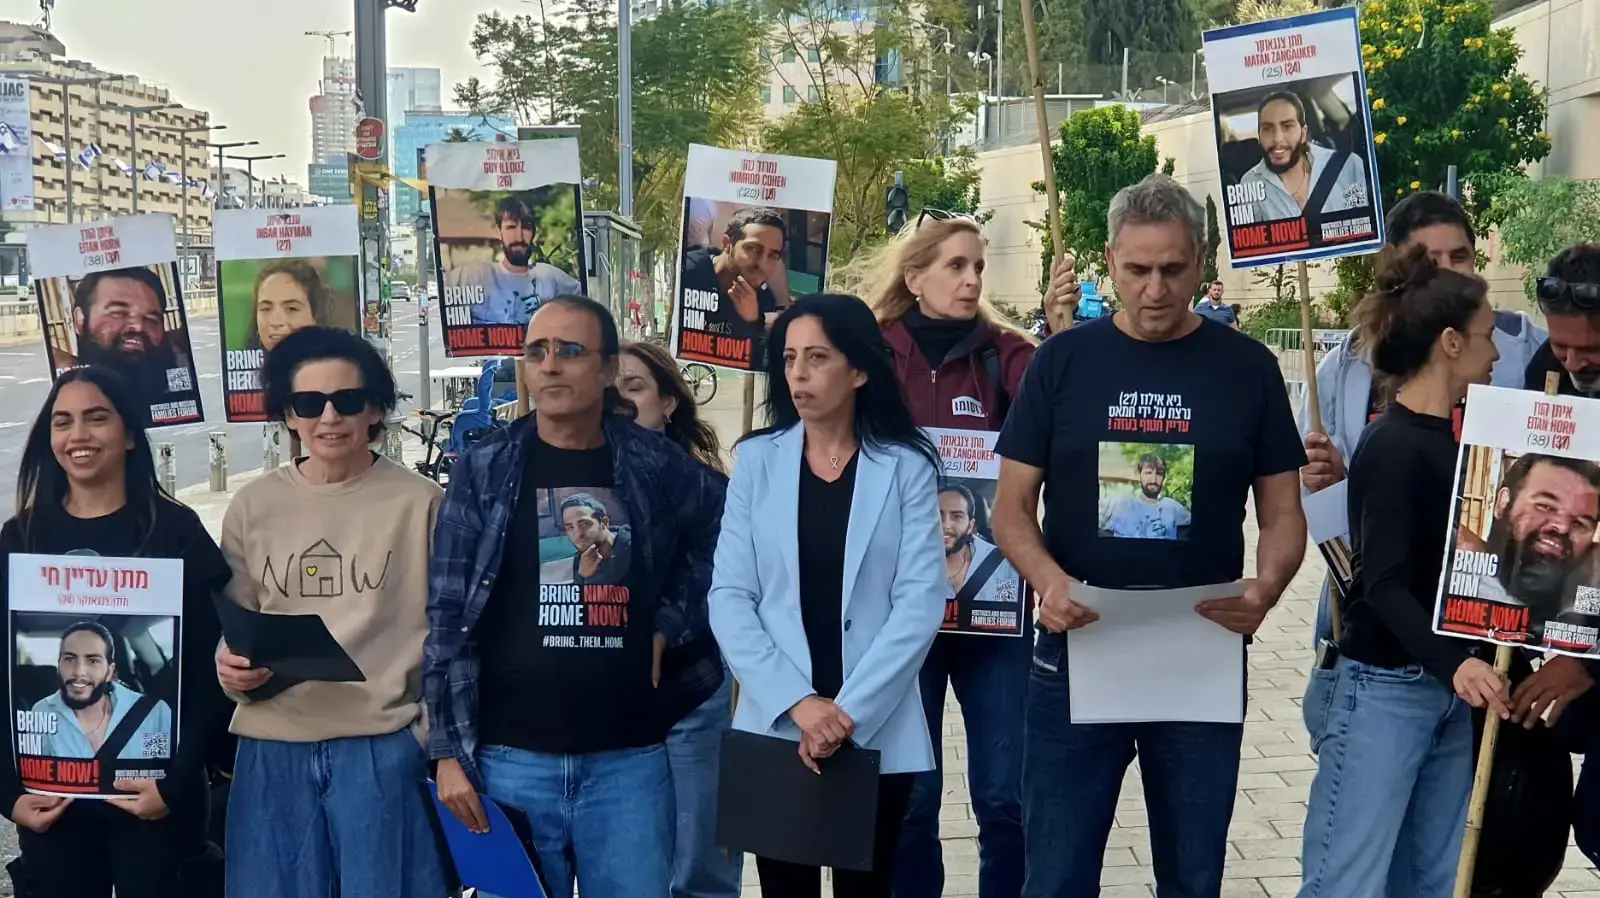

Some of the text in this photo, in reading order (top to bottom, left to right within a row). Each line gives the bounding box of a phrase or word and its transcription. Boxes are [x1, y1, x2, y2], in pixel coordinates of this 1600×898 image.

[1244, 45, 1317, 68] MATAN ZANGAUKER
[1261, 65, 1283, 80] (25)
[484, 161, 526, 174] GUY ILLOUZ
[496, 175, 512, 188] (26)
[730, 171, 787, 188] NIMROD COHEN
[1226, 181, 1266, 205] BRING
[1229, 204, 1255, 226] HIM
[256, 225, 312, 239] INBAR HAYMAN
[1232, 225, 1269, 249] HOME
[1270, 217, 1308, 244] NOW!
[78, 240, 99, 254] EITAN
[276, 239, 292, 251] (27)
[444, 285, 485, 306] BRING
[684, 287, 719, 312] BRING
[446, 306, 472, 326] HIM
[683, 308, 705, 331] HIM
[448, 327, 524, 349] HOME NOW!
[682, 330, 752, 361] HOME NOW!
[227, 349, 264, 370] BRING
[1119, 391, 1182, 407] גיא אילוז (27)
[1108, 405, 1191, 420] נרצח על ידי חמאס
[1527, 416, 1576, 435] EITAN HORN
[1527, 433, 1550, 449] (38)
[953, 448, 995, 461] ZANGAUKER
[1453, 549, 1498, 577] BRING
[41, 566, 149, 592] מתן עדיין חי
[1449, 576, 1480, 598] HIM
[539, 584, 630, 604] BRING NIMROD
[538, 604, 629, 628] HOME NOW!
[1445, 598, 1530, 632] HOME NOW!
[542, 635, 624, 649] #BRING_THEM_HOME
[1543, 628, 1598, 647] FAMILIES FORUM
[16, 710, 58, 734] BRING
[18, 733, 42, 755] HIM
[20, 758, 99, 783] HOME NOW!
